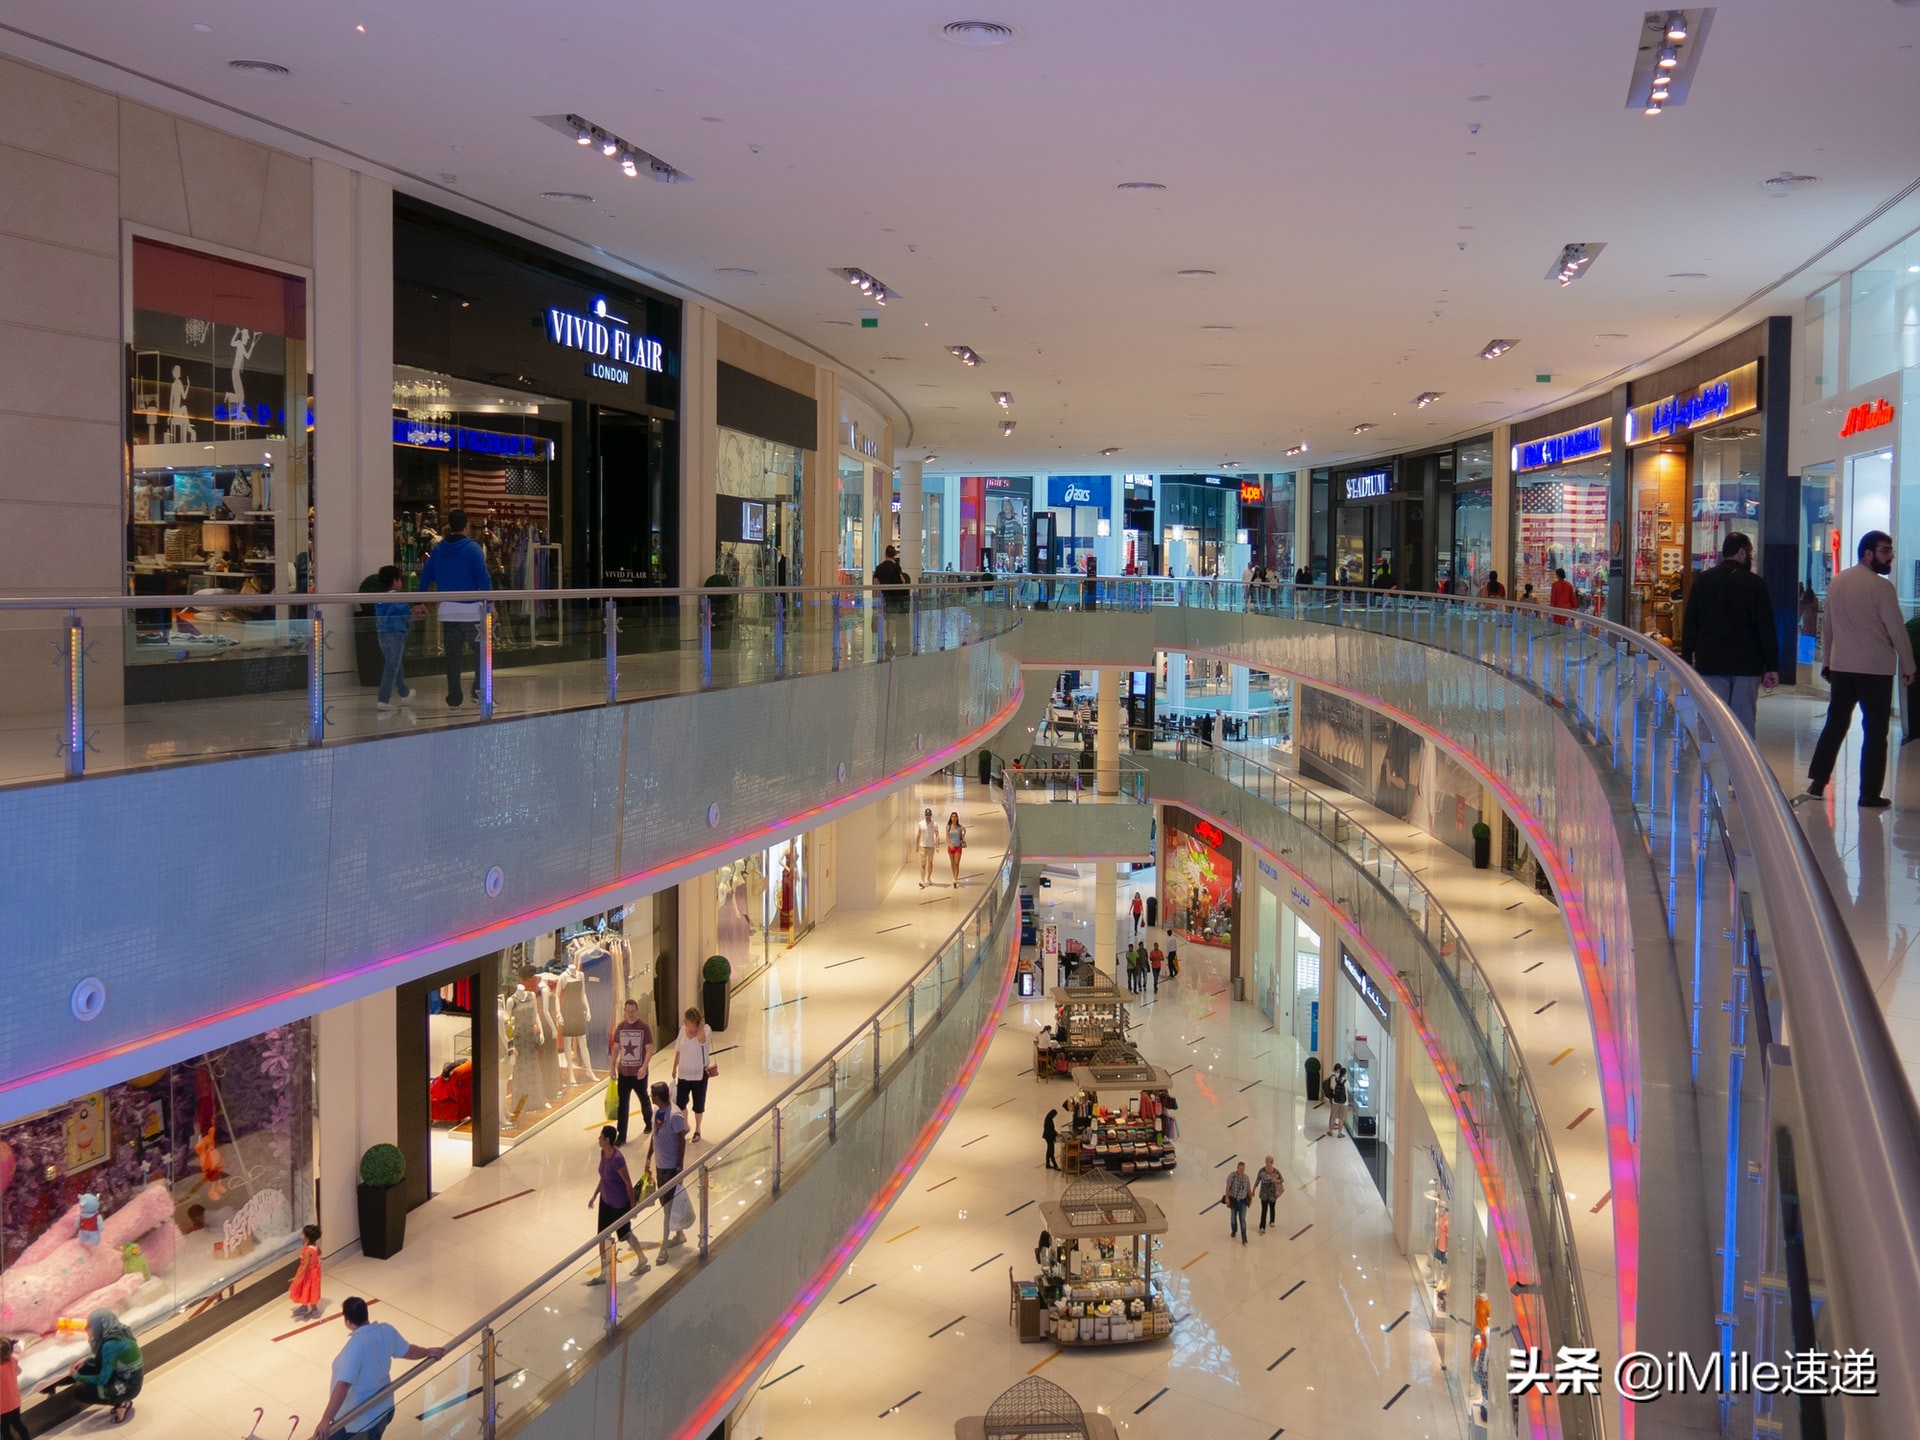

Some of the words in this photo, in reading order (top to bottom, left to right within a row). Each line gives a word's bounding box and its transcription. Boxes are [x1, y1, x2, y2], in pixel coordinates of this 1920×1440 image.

[551, 309, 609, 356] VIVID
[614, 329, 663, 373] FLAIR
[592, 362, 629, 385] LONDON
[1345, 473, 1386, 499] STADIUM
[605, 570, 625, 578] VIVID
[626, 571, 647, 579] FLAIR
